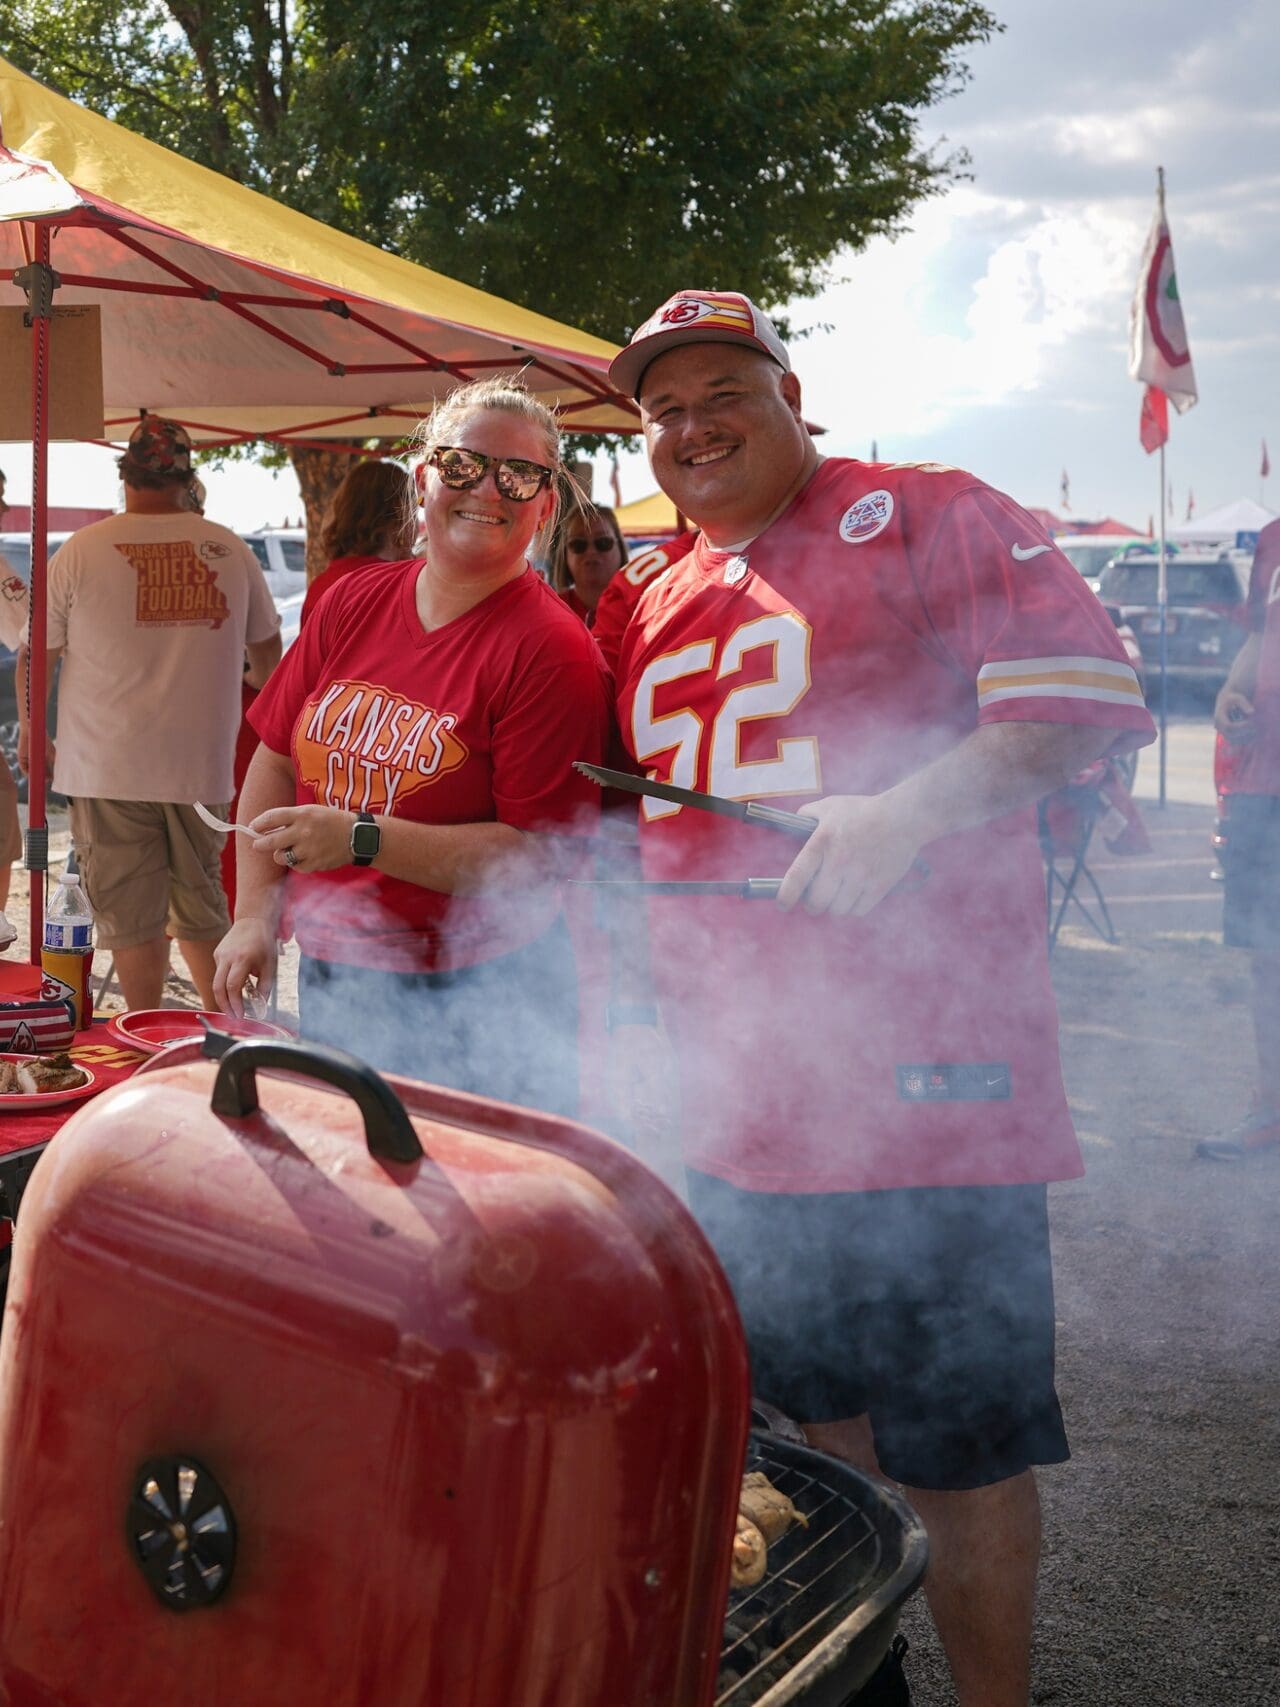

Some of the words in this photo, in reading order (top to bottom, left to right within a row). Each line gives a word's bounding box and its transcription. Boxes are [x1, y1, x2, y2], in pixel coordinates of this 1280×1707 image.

[121, 544, 166, 558] KANSAS
[171, 543, 194, 557] CITY
[134, 558, 208, 586] CHIEFS
[140, 585, 223, 612] FOOTBALL
[306, 684, 458, 776] KANSAS
[632, 611, 821, 823] 52
[324, 751, 403, 817] CITY
